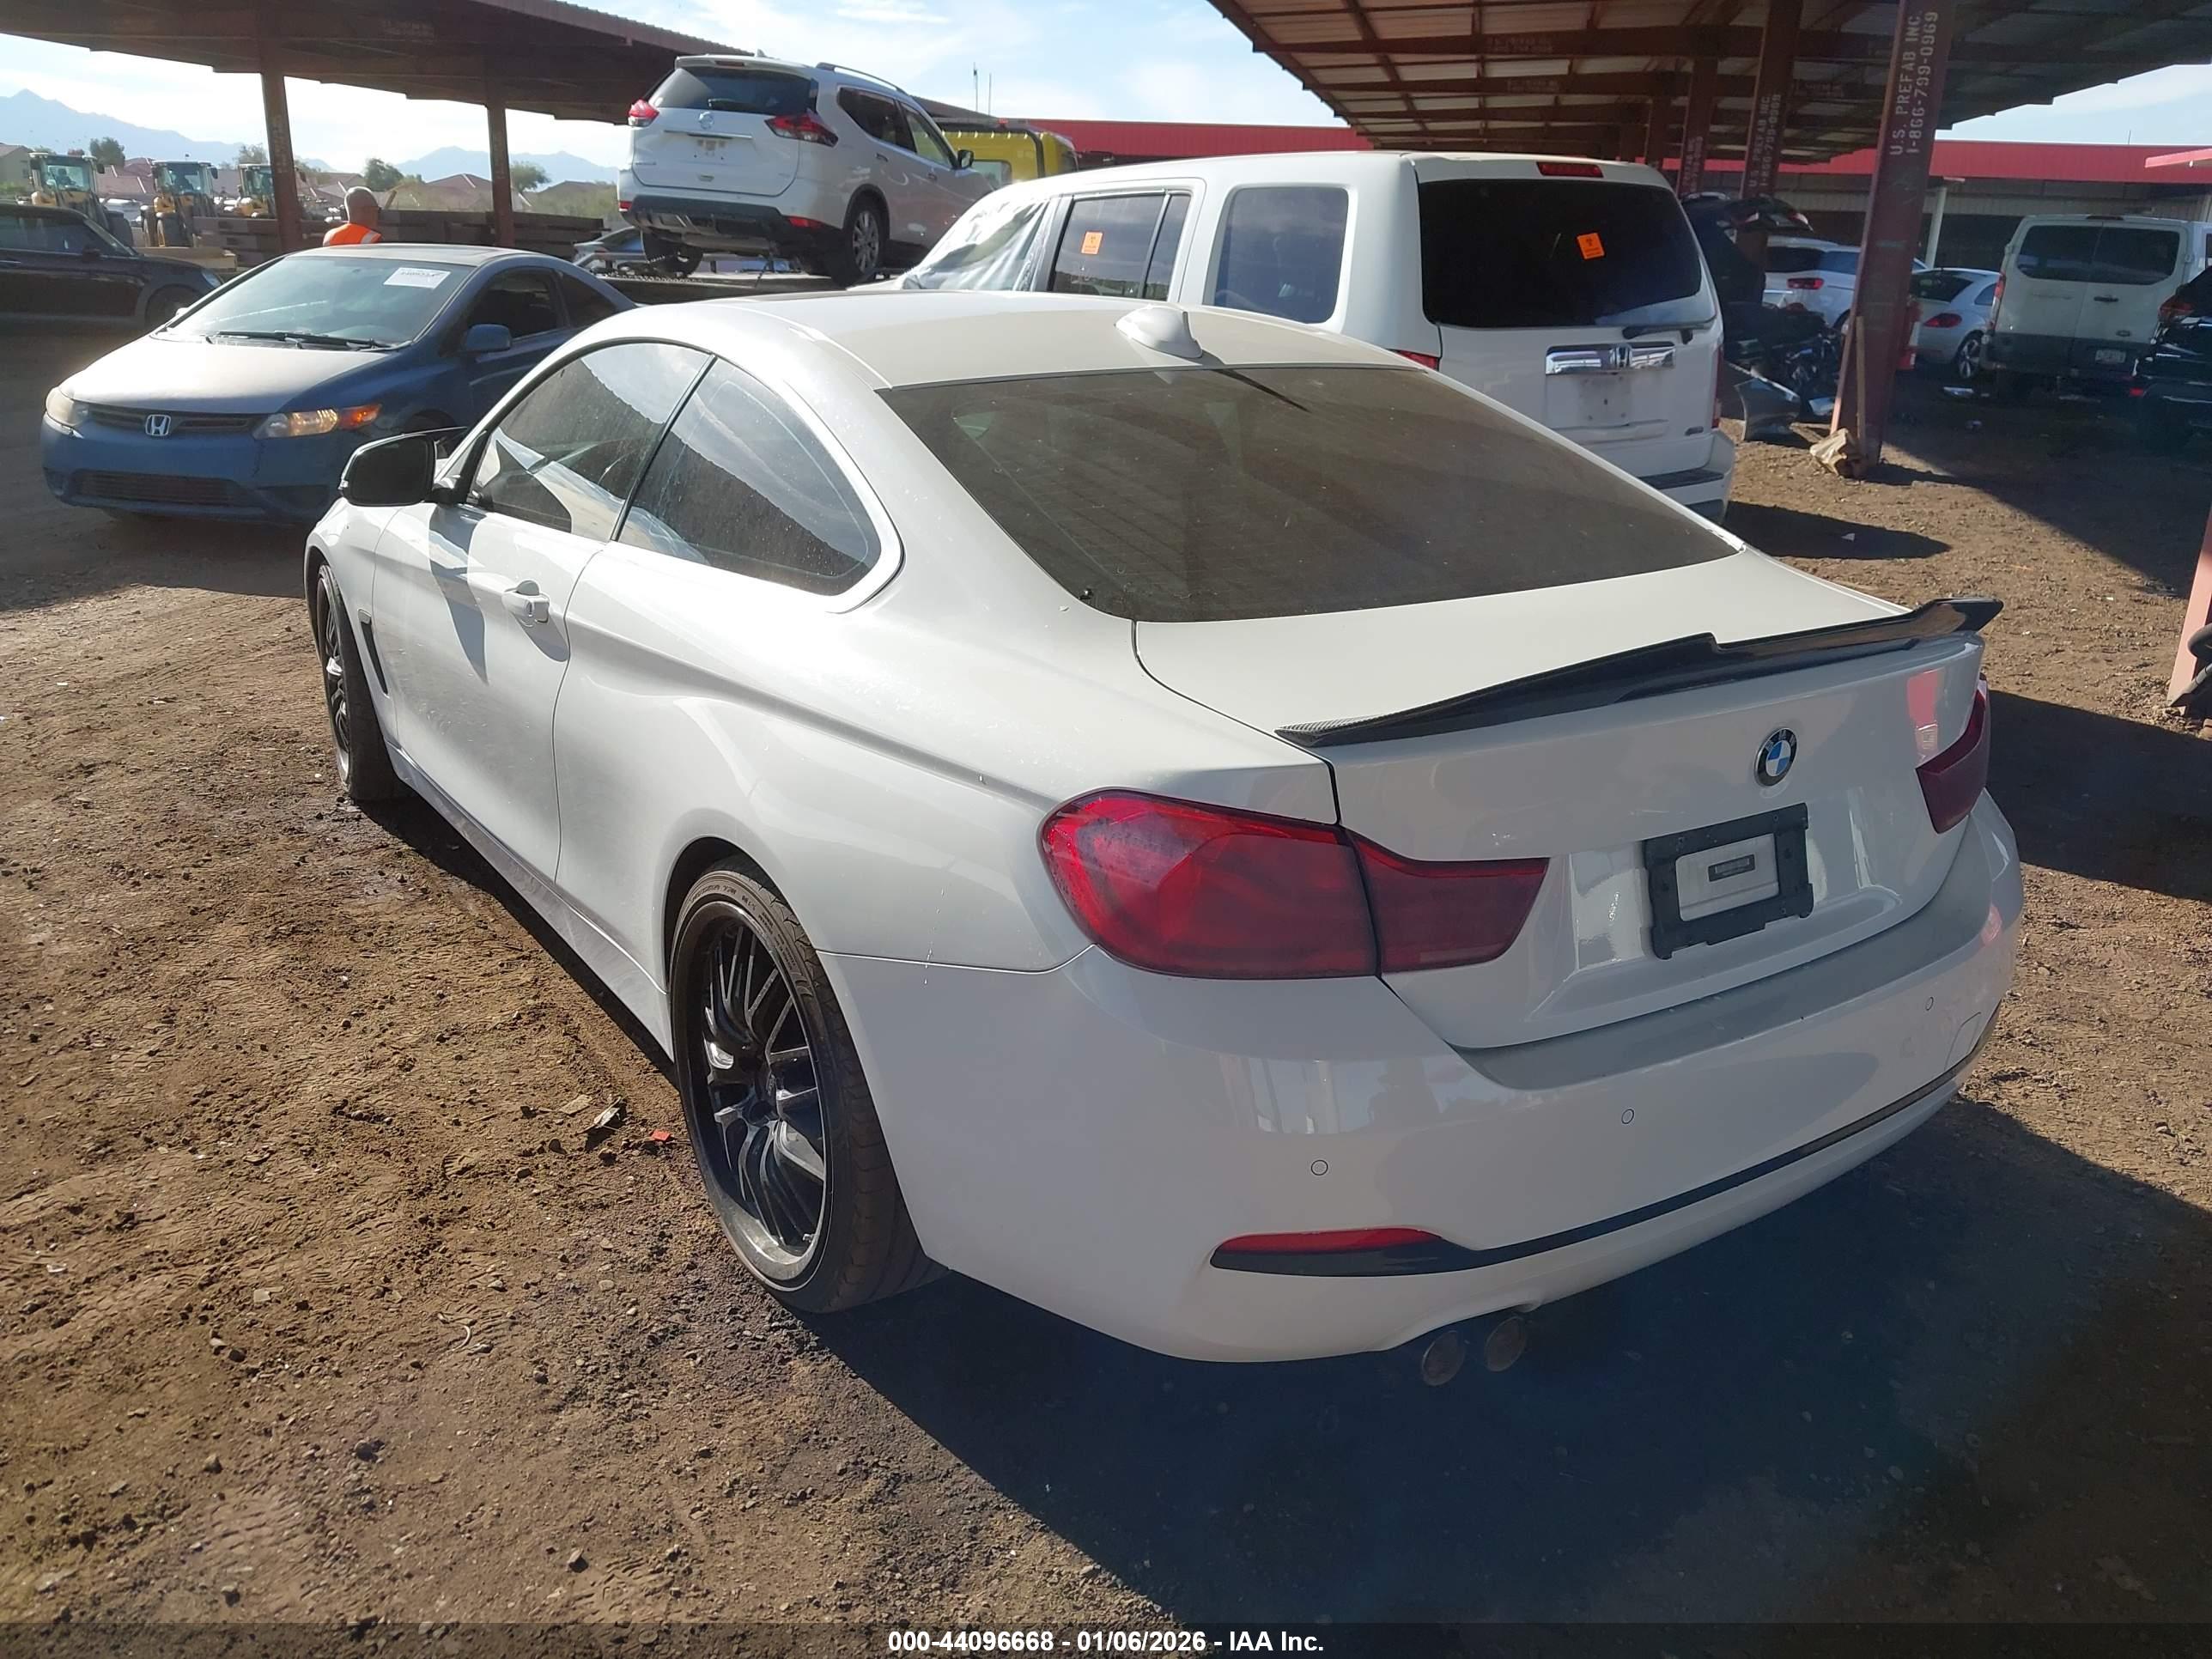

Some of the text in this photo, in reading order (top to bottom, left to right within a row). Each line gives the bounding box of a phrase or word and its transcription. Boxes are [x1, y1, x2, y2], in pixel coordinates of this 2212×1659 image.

[1896, 52, 1916, 114] PREFAB
[1906, 11, 1938, 154] 1-866-799-0969
[1890, 124, 1905, 155] U.S.
